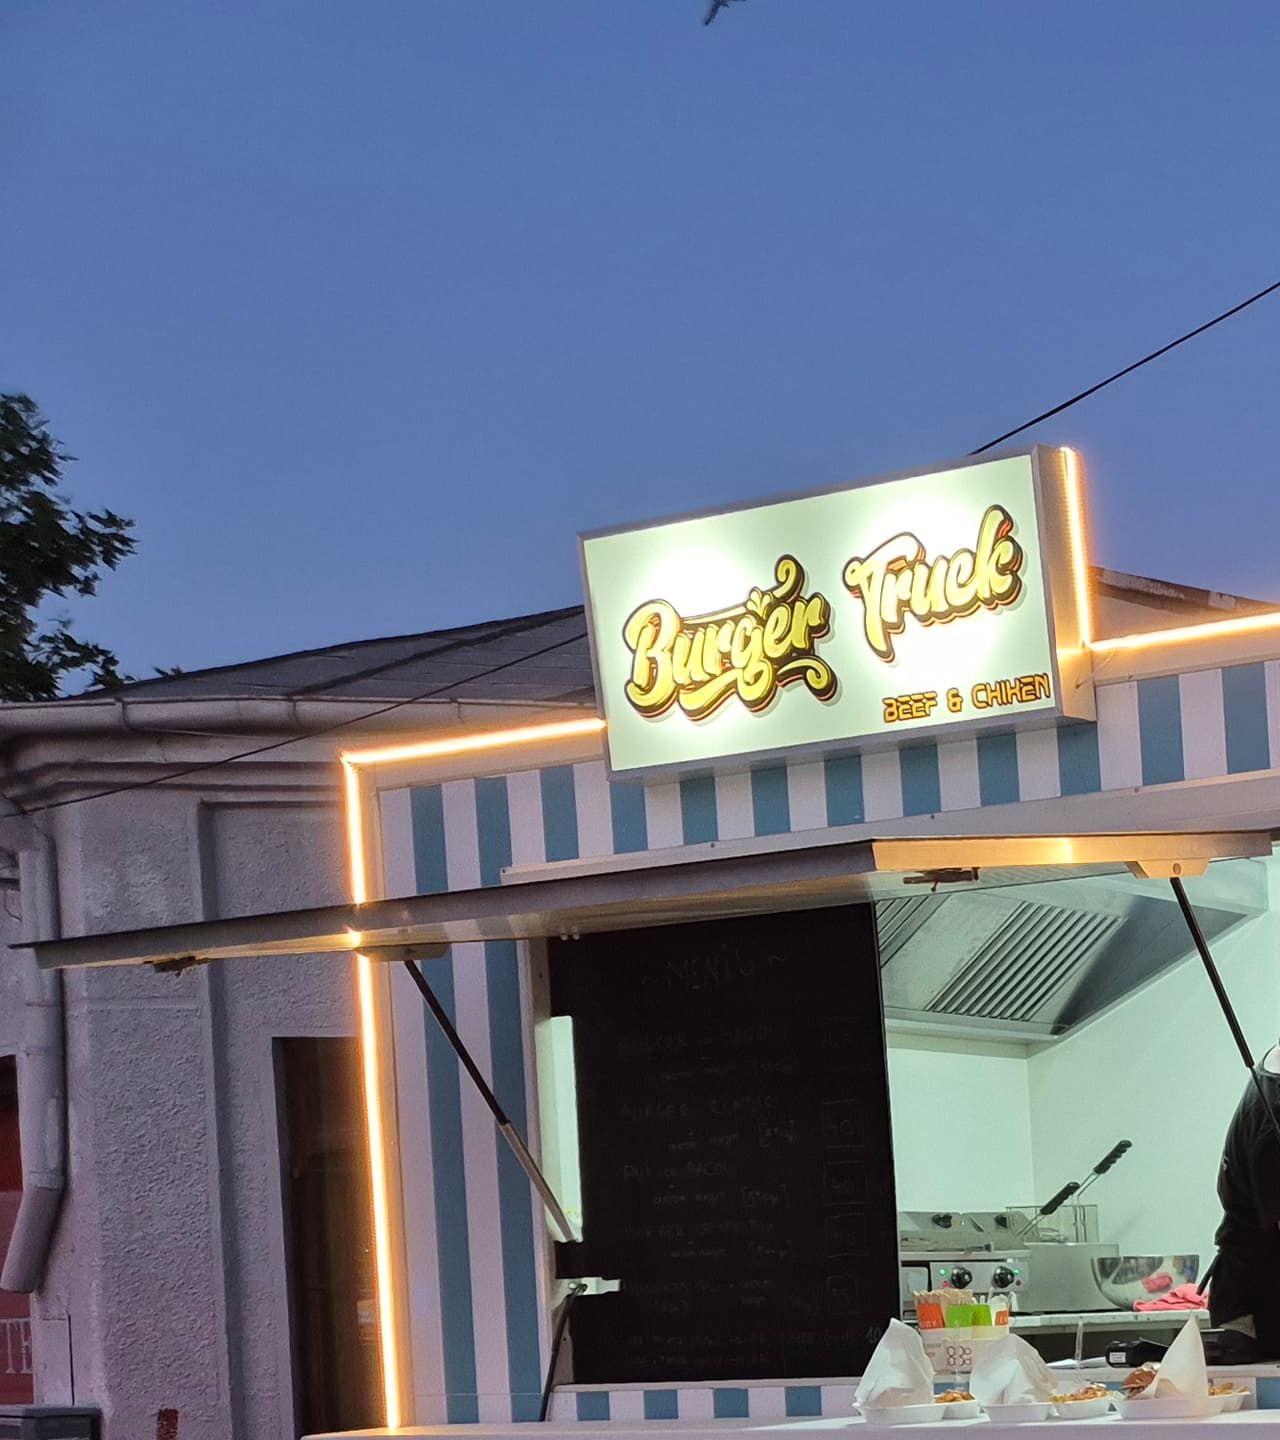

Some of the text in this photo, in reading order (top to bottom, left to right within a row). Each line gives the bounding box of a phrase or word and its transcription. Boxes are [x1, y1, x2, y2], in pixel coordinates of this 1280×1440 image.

[623, 504, 1022, 720] Burger Truck
[882, 673, 1051, 723] BEEF & CHIKEN
